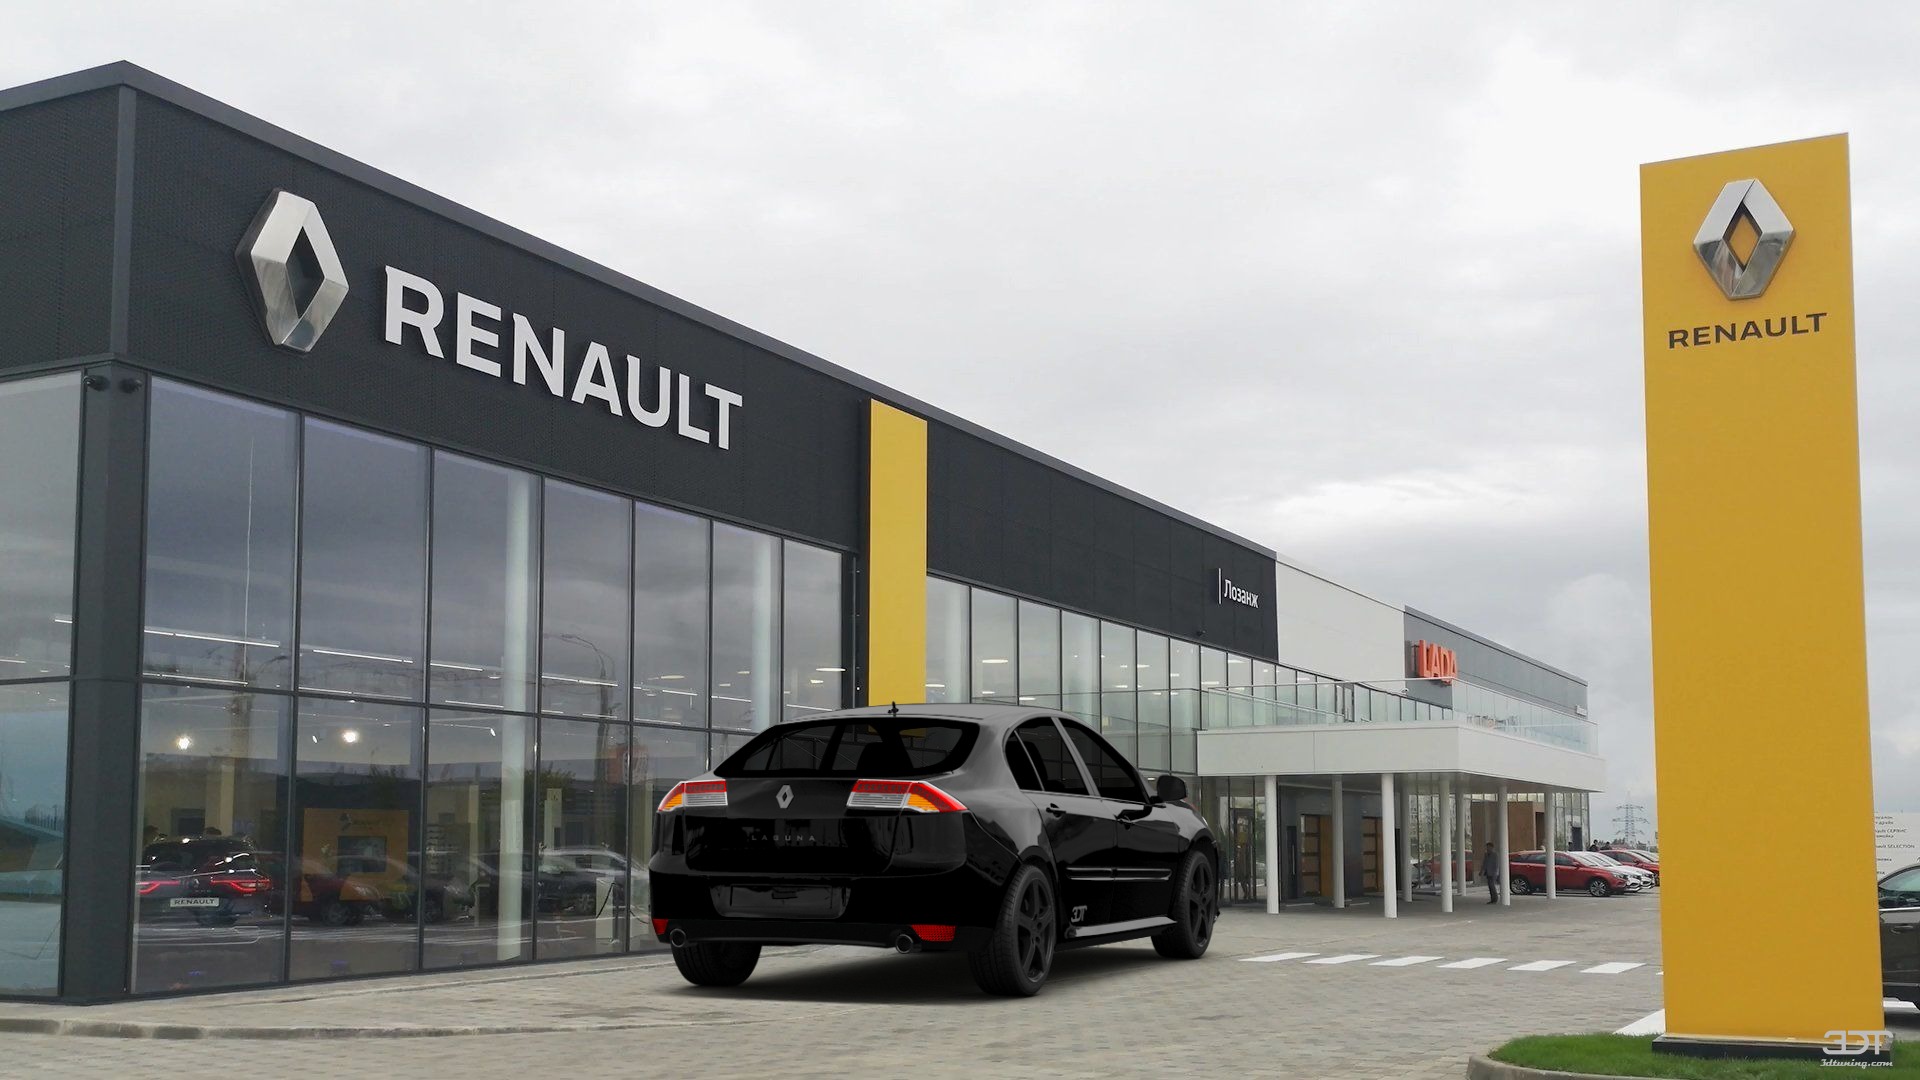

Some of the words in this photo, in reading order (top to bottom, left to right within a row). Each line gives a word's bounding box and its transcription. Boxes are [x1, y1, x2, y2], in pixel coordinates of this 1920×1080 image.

[1668, 312, 1828, 349] RENAULT
[385, 265, 743, 450] RENAULT
[1224, 579, 1259, 609] Лозанж
[1418, 639, 1458, 682] LADA
